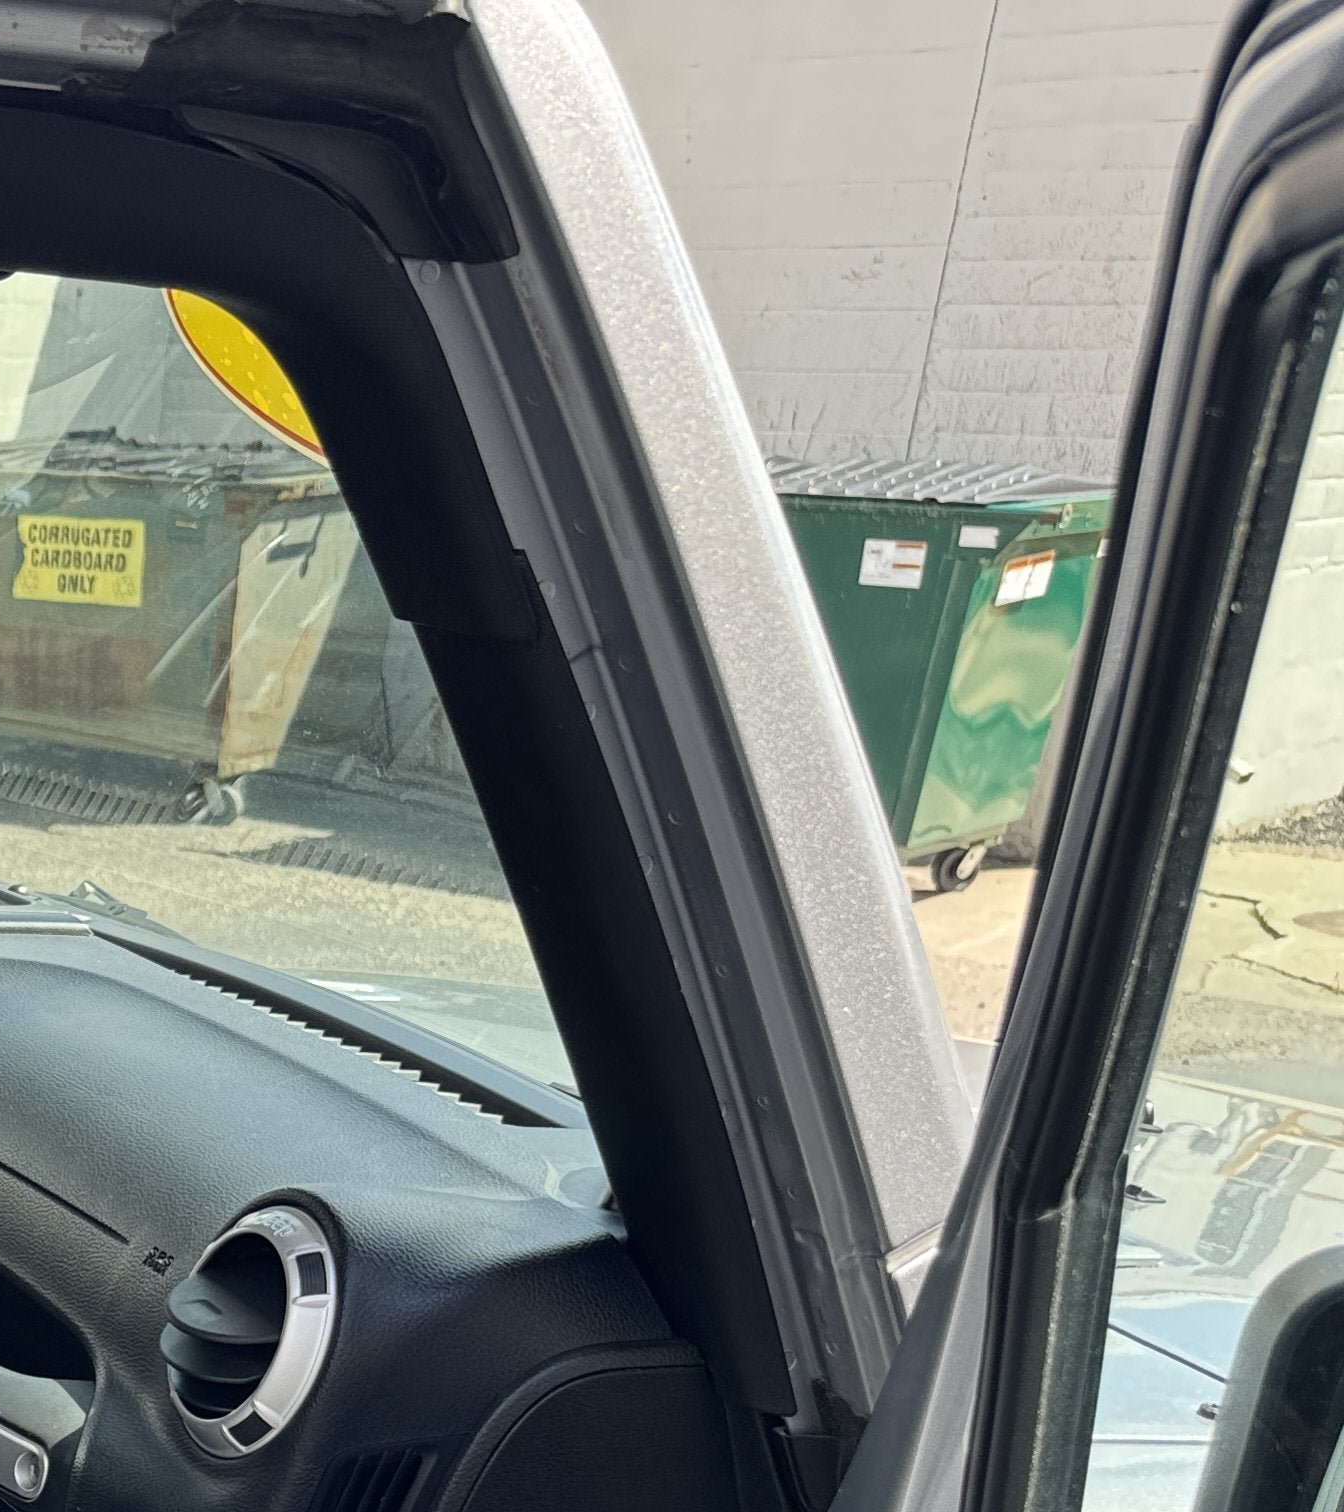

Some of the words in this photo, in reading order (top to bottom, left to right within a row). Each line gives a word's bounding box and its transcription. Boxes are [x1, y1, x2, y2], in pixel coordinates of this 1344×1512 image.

[28, 524, 133, 549] CORRUGATED
[31, 548, 126, 572] CARDBOARD
[57, 574, 97, 594] ONLY
